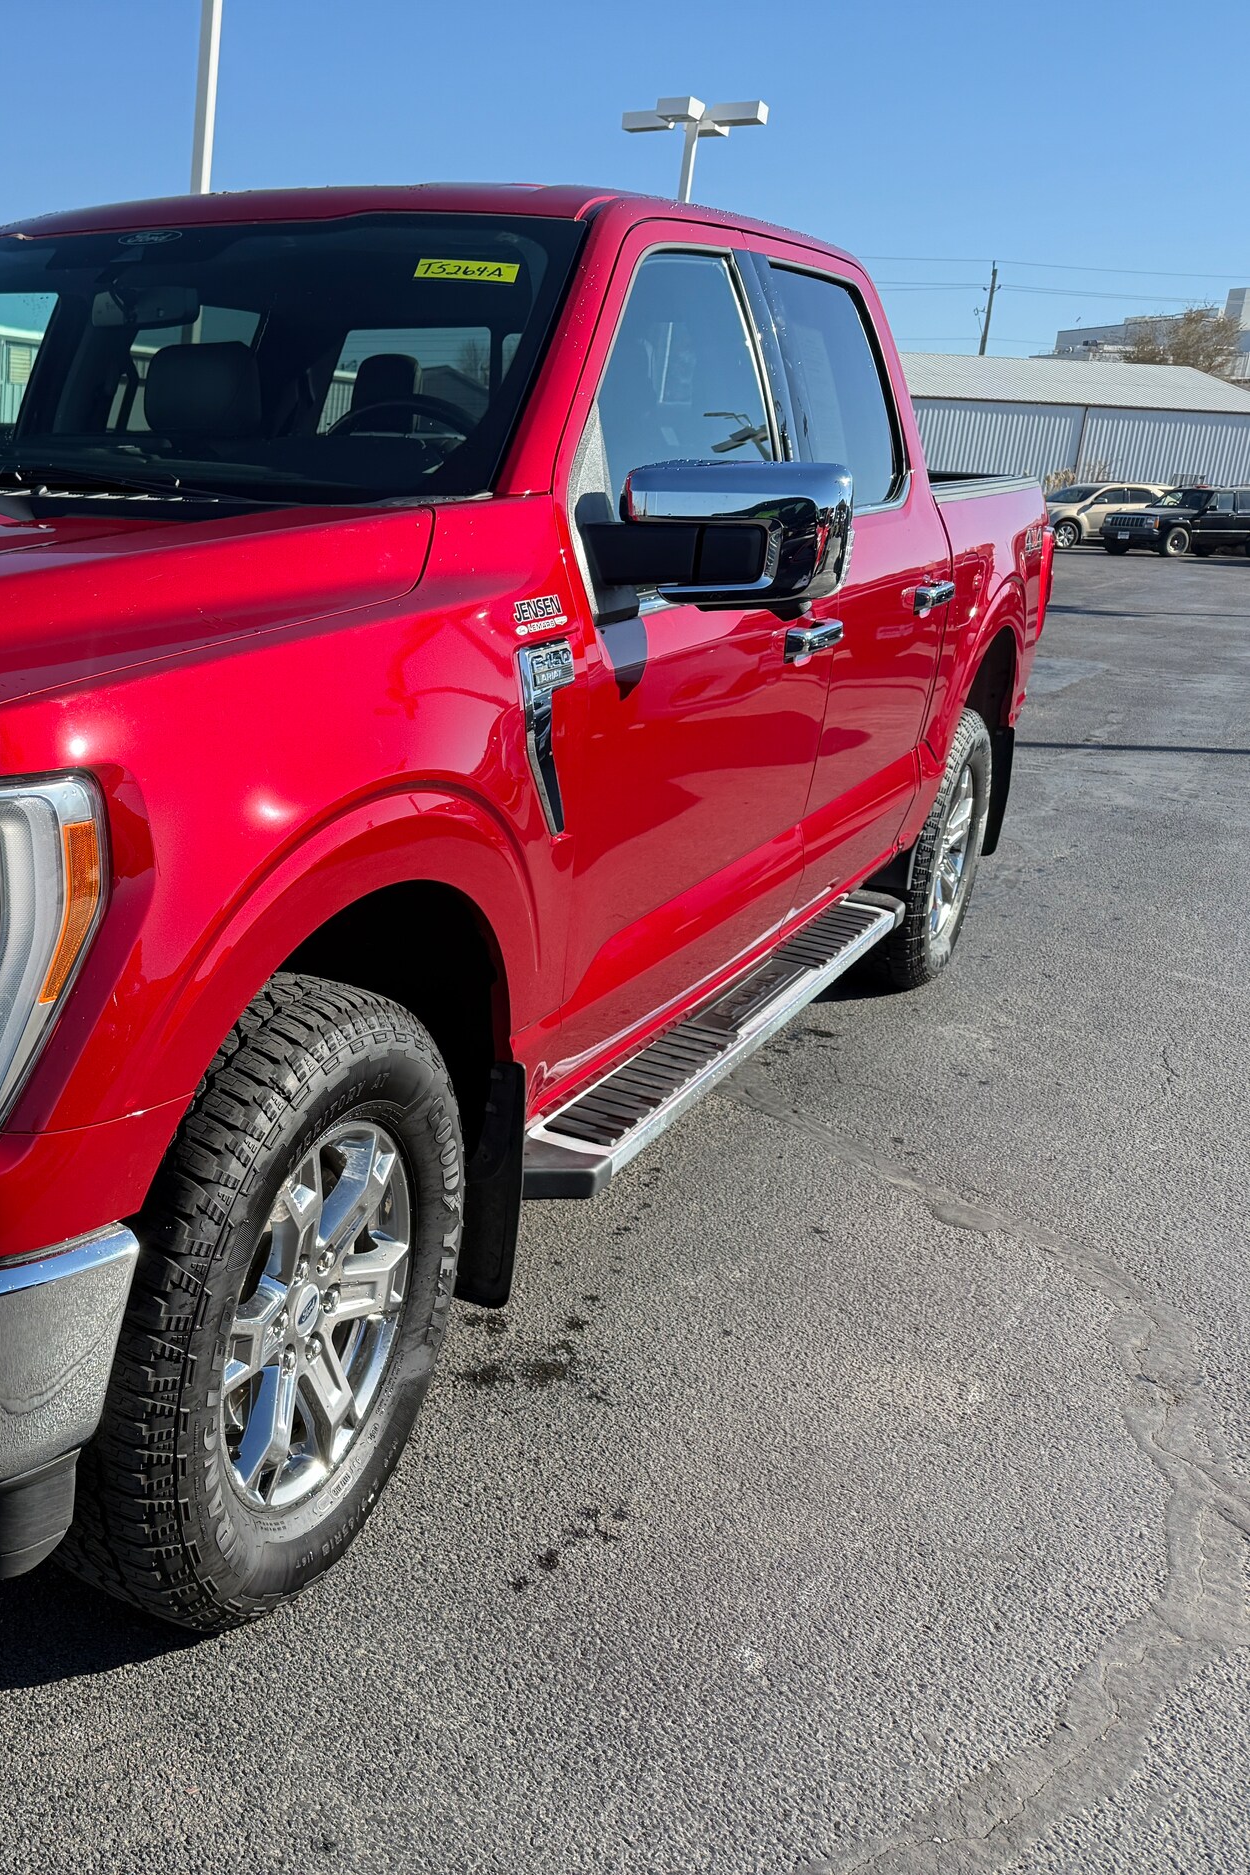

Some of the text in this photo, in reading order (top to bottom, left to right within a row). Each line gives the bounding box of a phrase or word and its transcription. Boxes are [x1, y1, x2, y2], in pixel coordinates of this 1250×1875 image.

[126, 231, 173, 244] Ford
[514, 595, 562, 623] JENSEN
[528, 618, 556, 632] LEMARS
[531, 649, 572, 672] F-150
[536, 669, 563, 684] LARIAT
[287, 1080, 366, 1169] TERRITORY
[371, 1072, 390, 1090] AT
[425, 1097, 461, 1347] GOODYEAR
[300, 1297, 316, 1322] Ford
